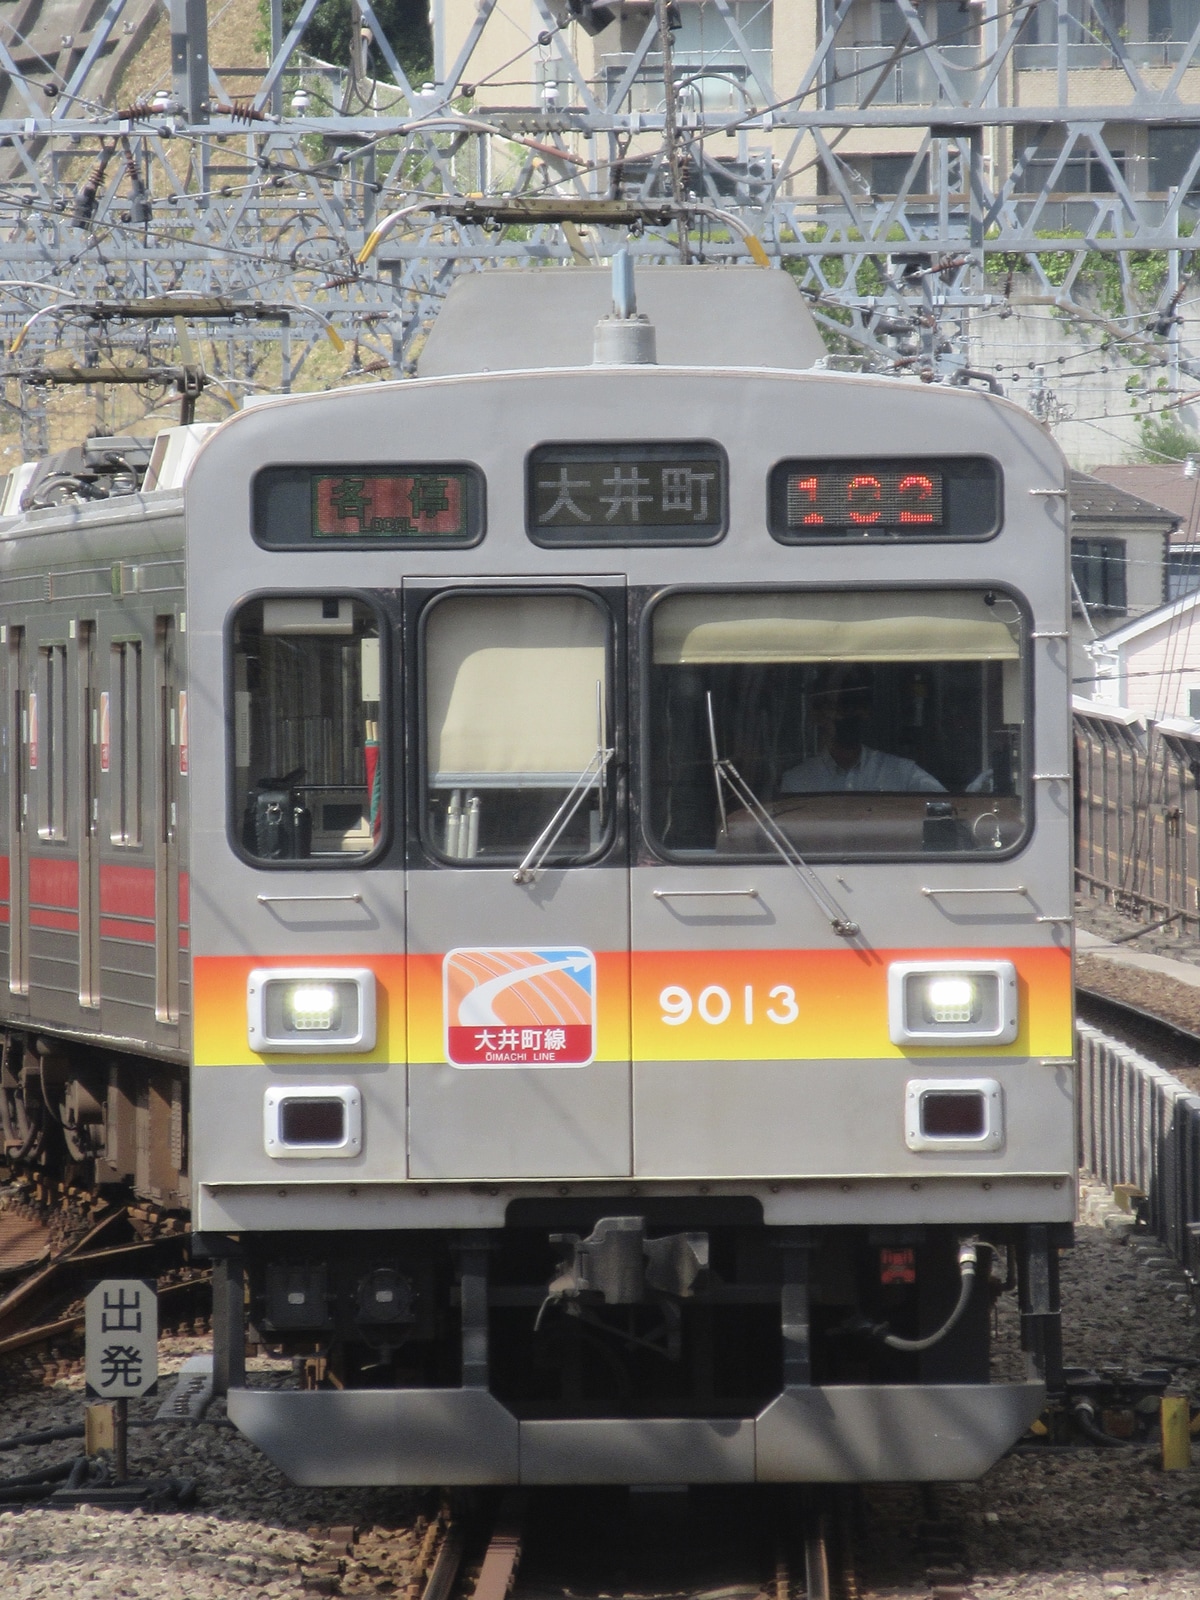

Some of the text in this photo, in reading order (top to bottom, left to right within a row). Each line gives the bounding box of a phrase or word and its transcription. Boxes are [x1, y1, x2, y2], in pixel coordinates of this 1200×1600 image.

[330, 478, 450, 519] 各停
[538, 466, 715, 523] 大井町
[799, 475, 933, 524] 102
[359, 517, 418, 532] LOCAL
[658, 985, 800, 1026] 9013
[473, 1028, 567, 1051] 大井町線
[533, 1052, 556, 1061] LINE
[101, 1288, 143, 1388] 出発
